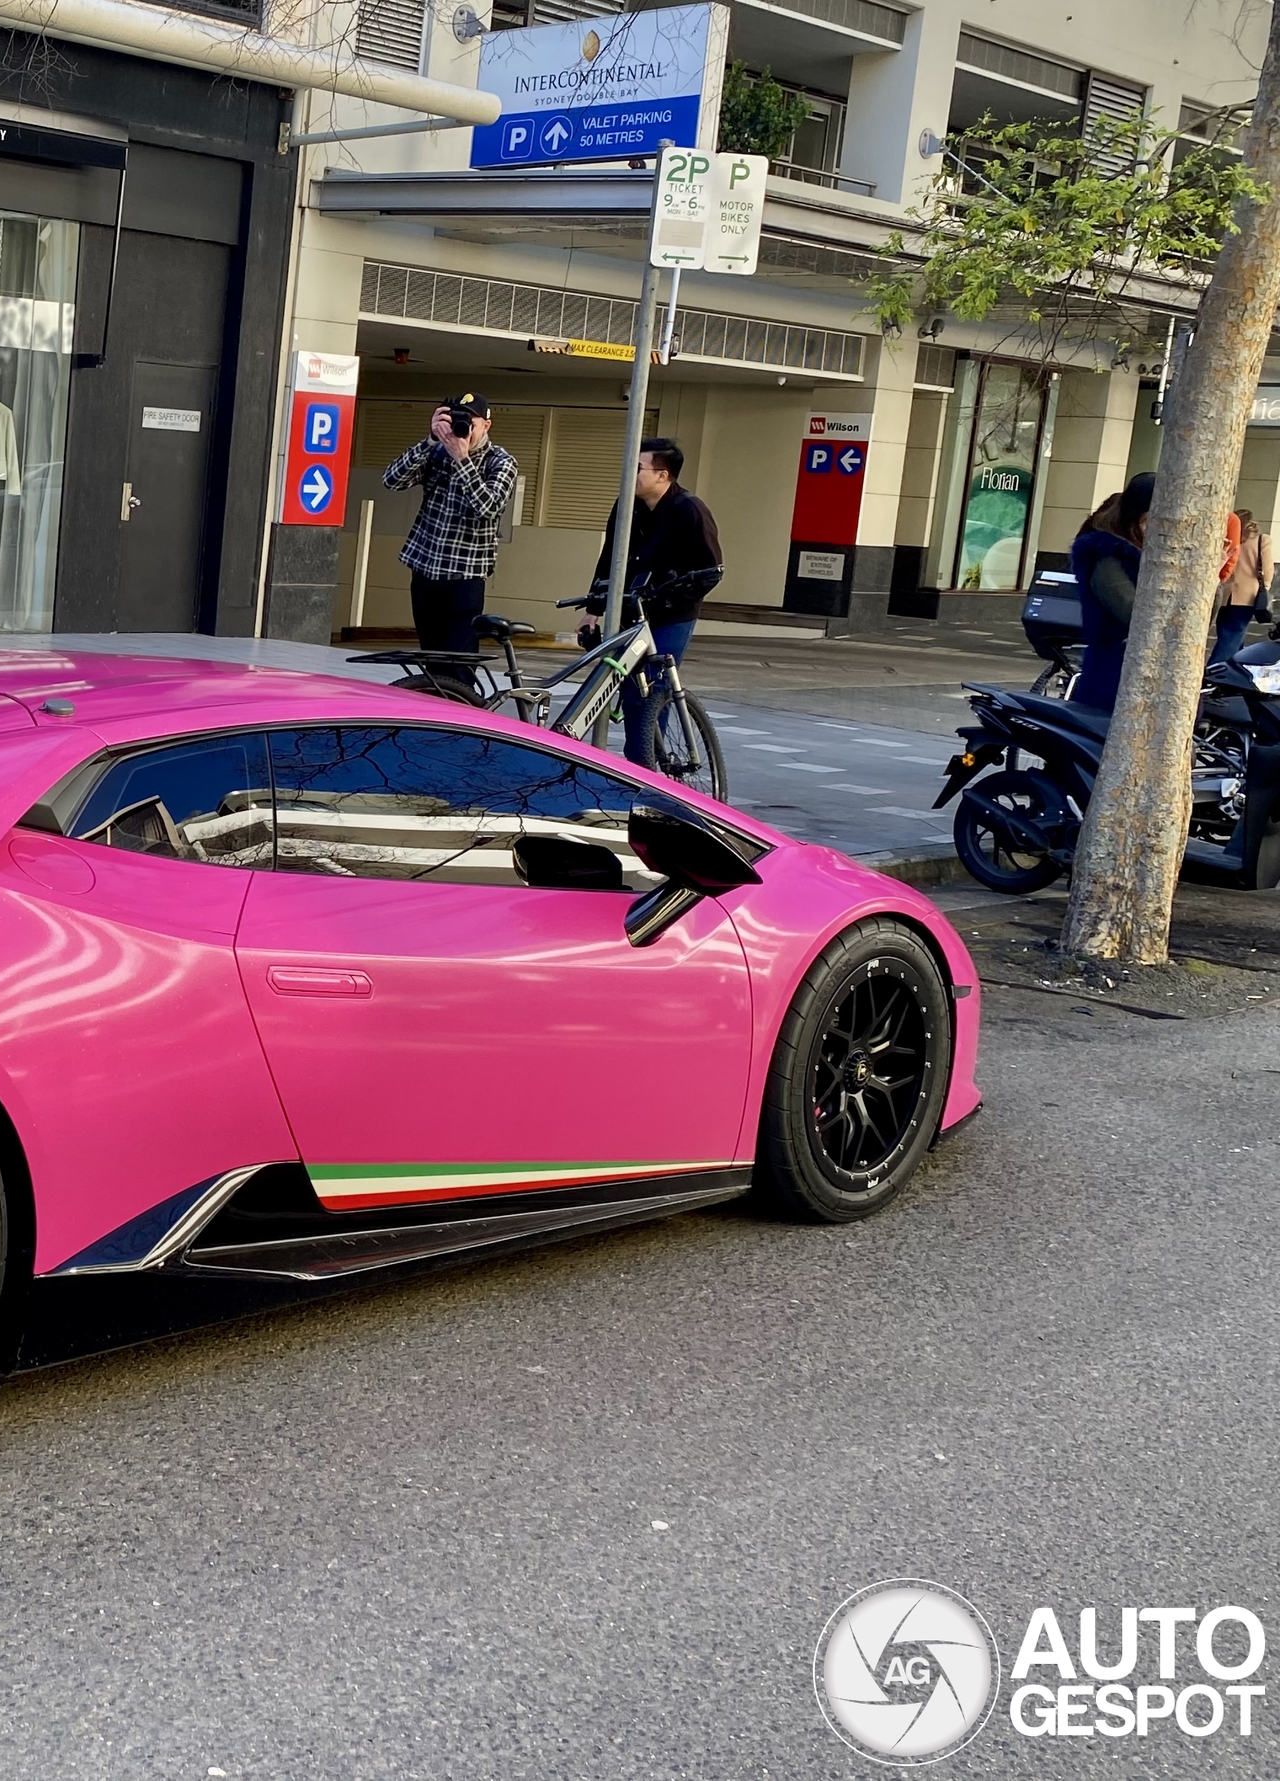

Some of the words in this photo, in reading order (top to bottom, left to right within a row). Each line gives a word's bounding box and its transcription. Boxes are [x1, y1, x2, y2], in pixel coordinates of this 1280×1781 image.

[535, 95, 572, 106] SYDNEY
[577, 91, 615, 102] DOUBLE
[621, 88, 639, 98] BAY
[582, 116, 618, 130] VALET
[621, 110, 672, 127] PARKING
[579, 134, 593, 147] 50
[596, 130, 644, 146] METRES
[666, 154, 710, 183] 2P
[729, 163, 751, 190] P
[669, 182, 704, 194] TICKET
[720, 200, 754, 212] MOTOR
[720, 212, 750, 223] BIKES
[721, 224, 748, 235] ONLY
[586, 345, 625, 357] CLEARANCE
[322, 365, 348, 376] Wilson
[144, 411, 157, 420] FIRE
[158, 412, 181, 421] SAFETY
[181, 413, 200, 423] DOOR
[311, 412, 332, 445] P
[826, 422, 860, 432] Wilson
[811, 450, 827, 469] P
[980, 467, 1020, 491] Florian
